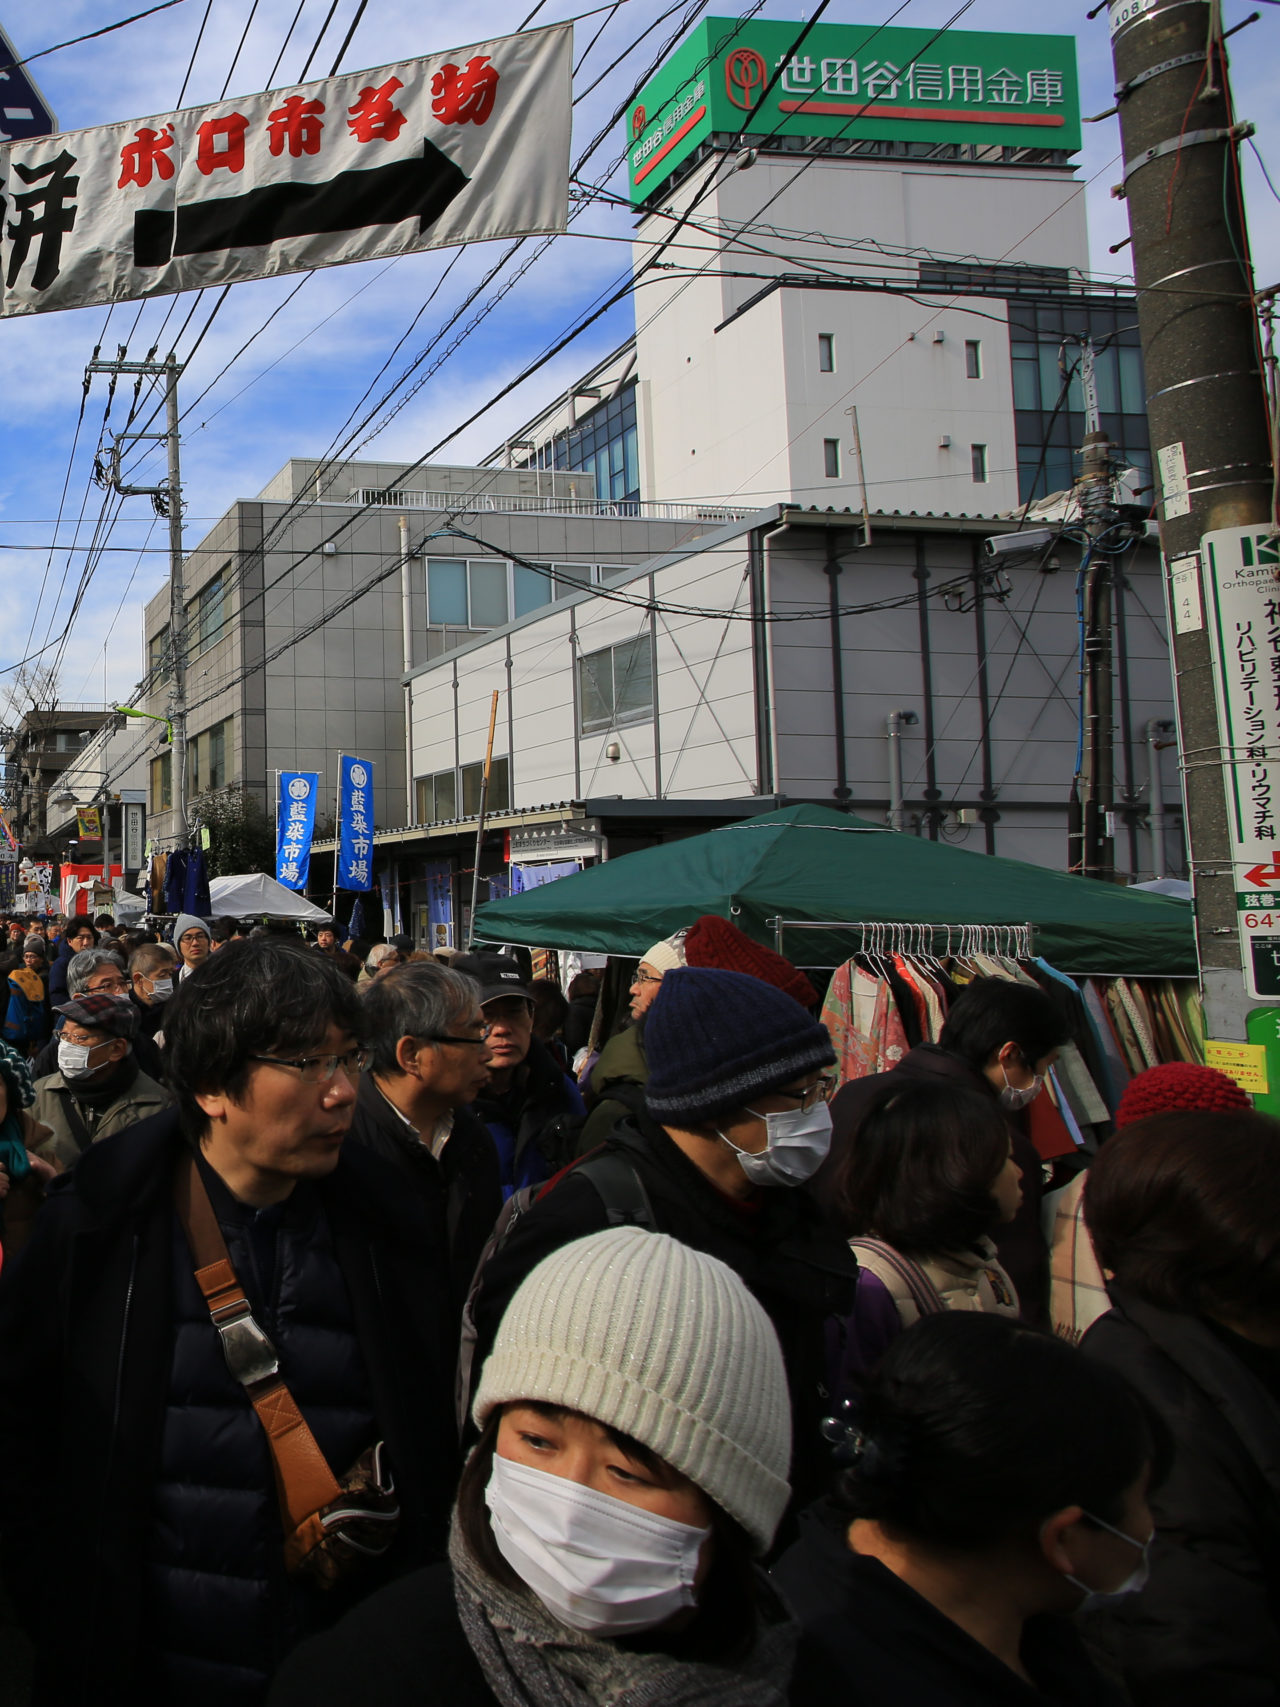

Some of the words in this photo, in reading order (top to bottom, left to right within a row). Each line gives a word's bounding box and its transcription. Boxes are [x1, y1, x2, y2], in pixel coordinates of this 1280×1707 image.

[117, 55, 500, 189] ボロ市名物
[633, 80, 705, 168] 世田谷信用金庫
[775, 54, 1064, 107] 世田谷信用金庫
[1236, 620, 1276, 841] リハビリテーション科・リウマチ科
[279, 801, 308, 882] 藍染市場
[348, 789, 370, 884] 藍染市場
